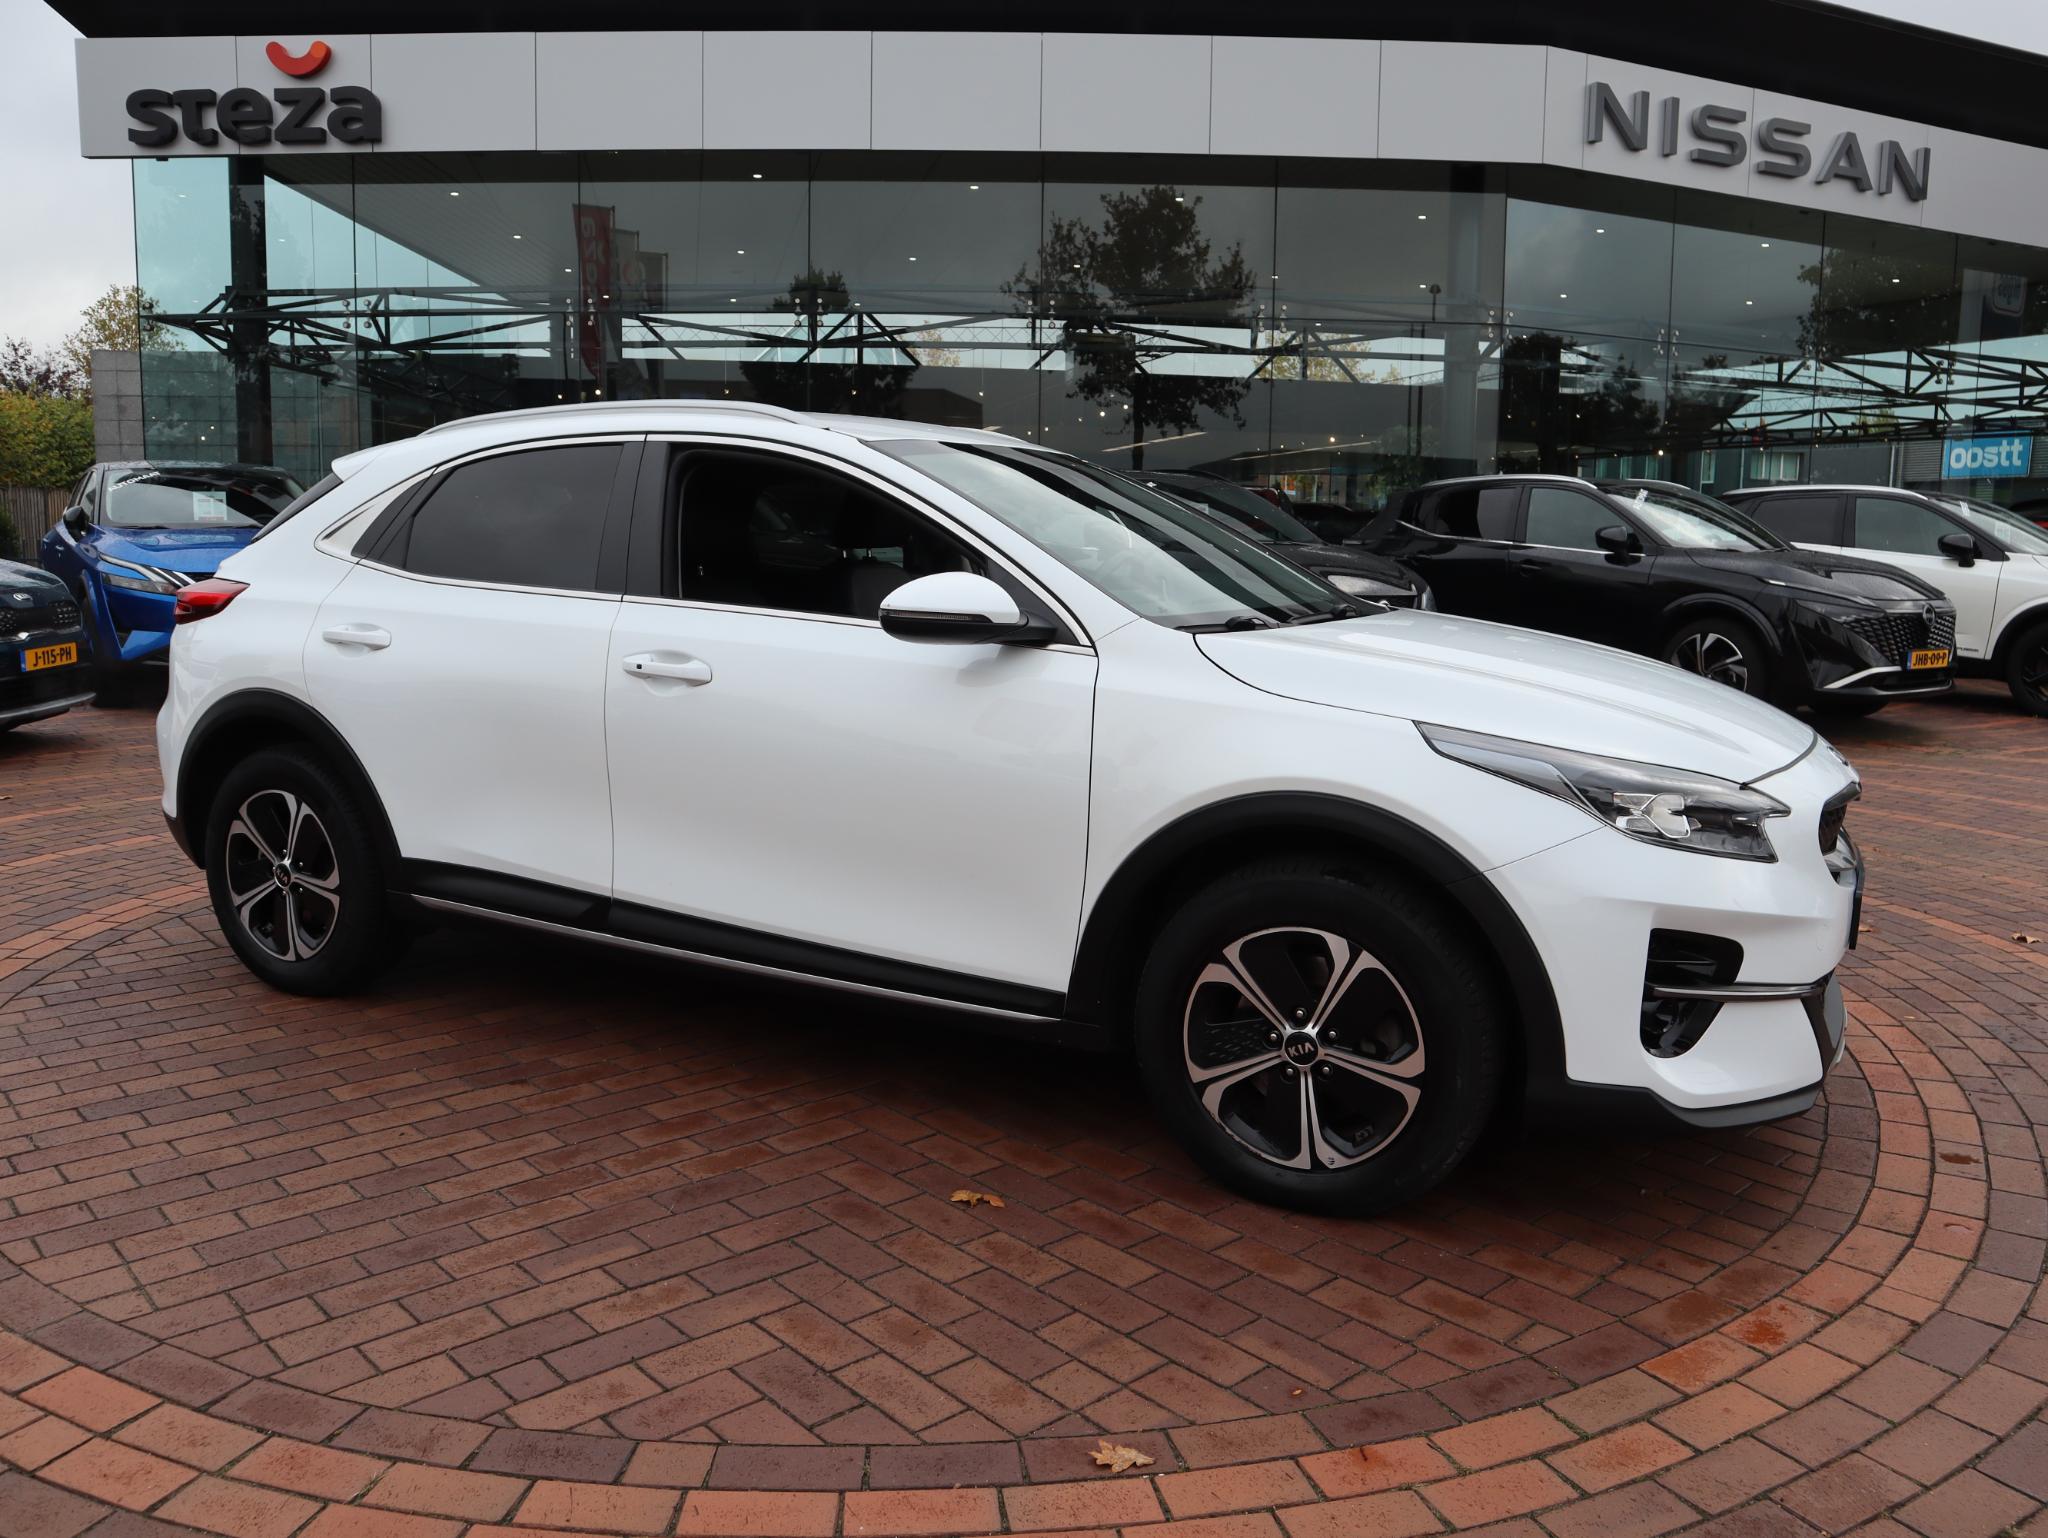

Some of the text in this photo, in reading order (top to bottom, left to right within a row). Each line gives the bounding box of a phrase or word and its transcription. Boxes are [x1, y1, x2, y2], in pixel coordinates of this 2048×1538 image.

[125, 85, 383, 148] steza
[1586, 81, 1931, 202] NISSAN
[1950, 438, 2023, 469] oostt
[108, 471, 160, 492] AUTOMAAT
[33, 646, 72, 667] J-115-PH
